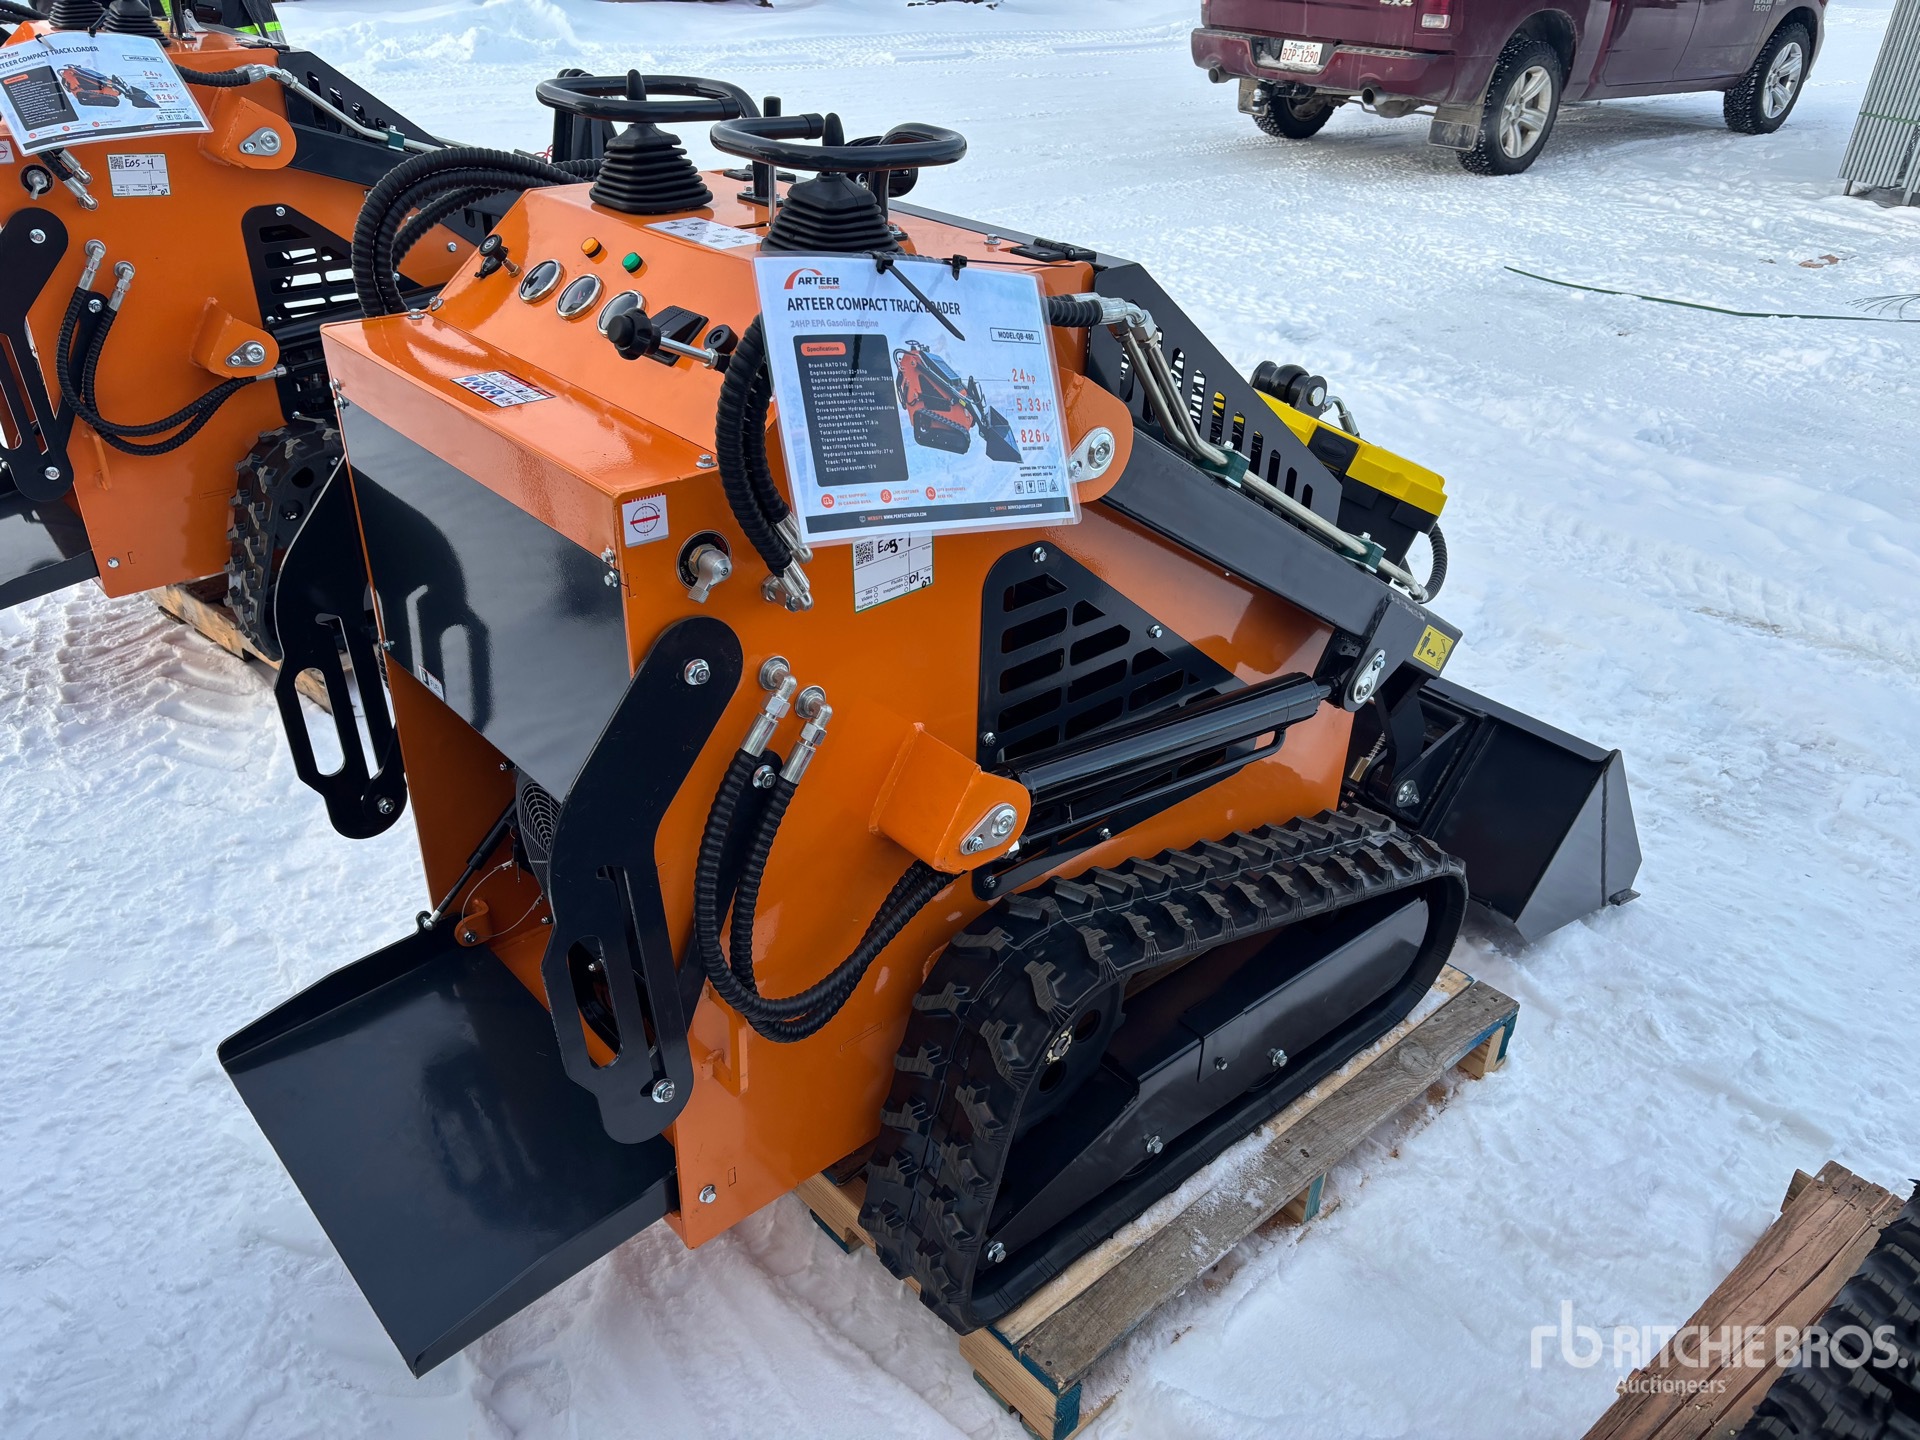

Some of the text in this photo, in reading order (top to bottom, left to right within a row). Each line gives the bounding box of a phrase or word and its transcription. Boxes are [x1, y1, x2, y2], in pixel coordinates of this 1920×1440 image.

[1752, 4, 1772, 12] 1500
[18, 51, 49, 63] COMPACT
[50, 47, 72, 56] TRACK
[72, 45, 100, 53] LOADER
[1281, 47, 1319, 64] BZP-1290
[124, 157, 154, 169] E05-4
[798, 276, 840, 285] ARTEER
[787, 297, 834, 311] ARTEER
[836, 297, 888, 312] COMPACT
[889, 298, 924, 313] TRACK
[790, 319, 879, 329] 24HP EPA Gasoline Engine
[883, 583, 904, 594] Inspection
